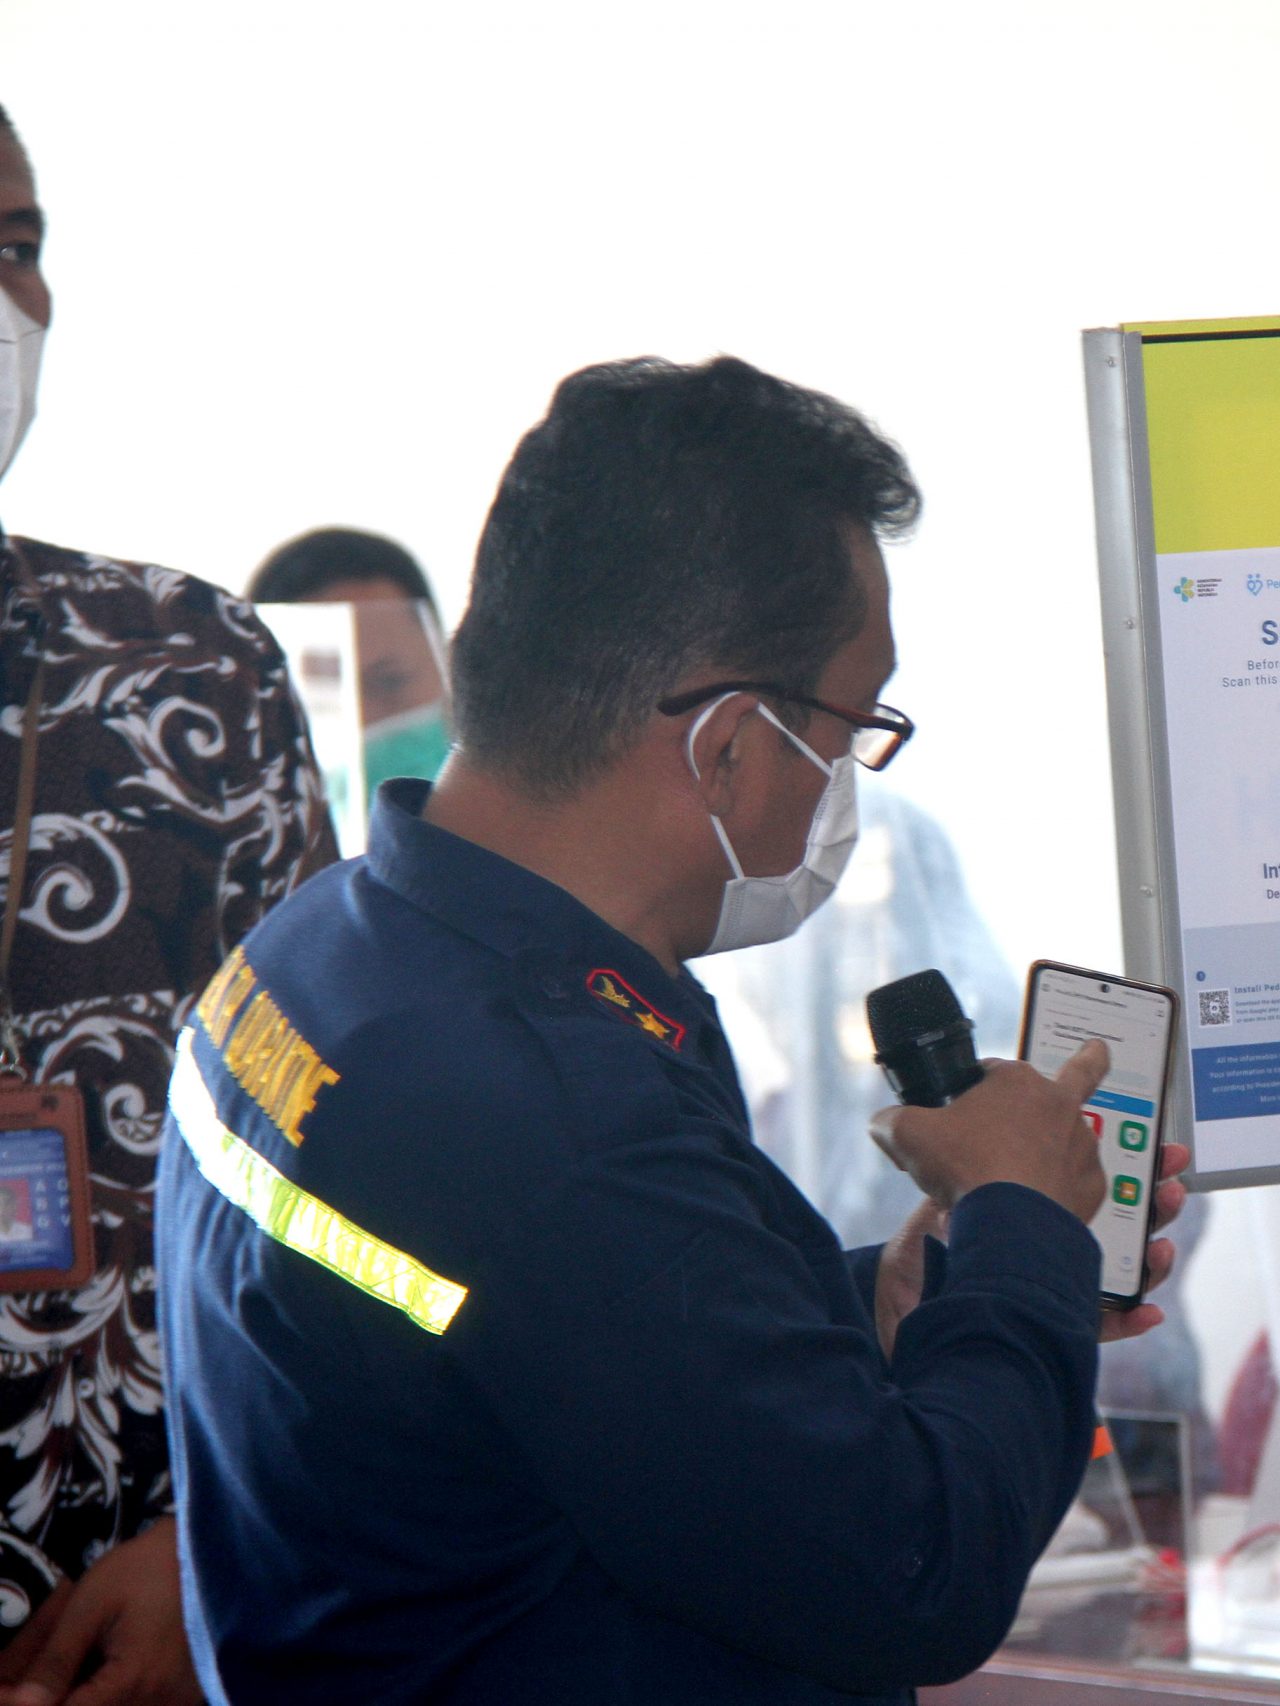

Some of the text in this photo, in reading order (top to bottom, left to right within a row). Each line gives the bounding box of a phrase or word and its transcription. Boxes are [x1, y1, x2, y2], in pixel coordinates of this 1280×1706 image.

[1222, 677, 1250, 688] Scan
[1256, 674, 1277, 685] this
[1234, 985, 1261, 994] Install
